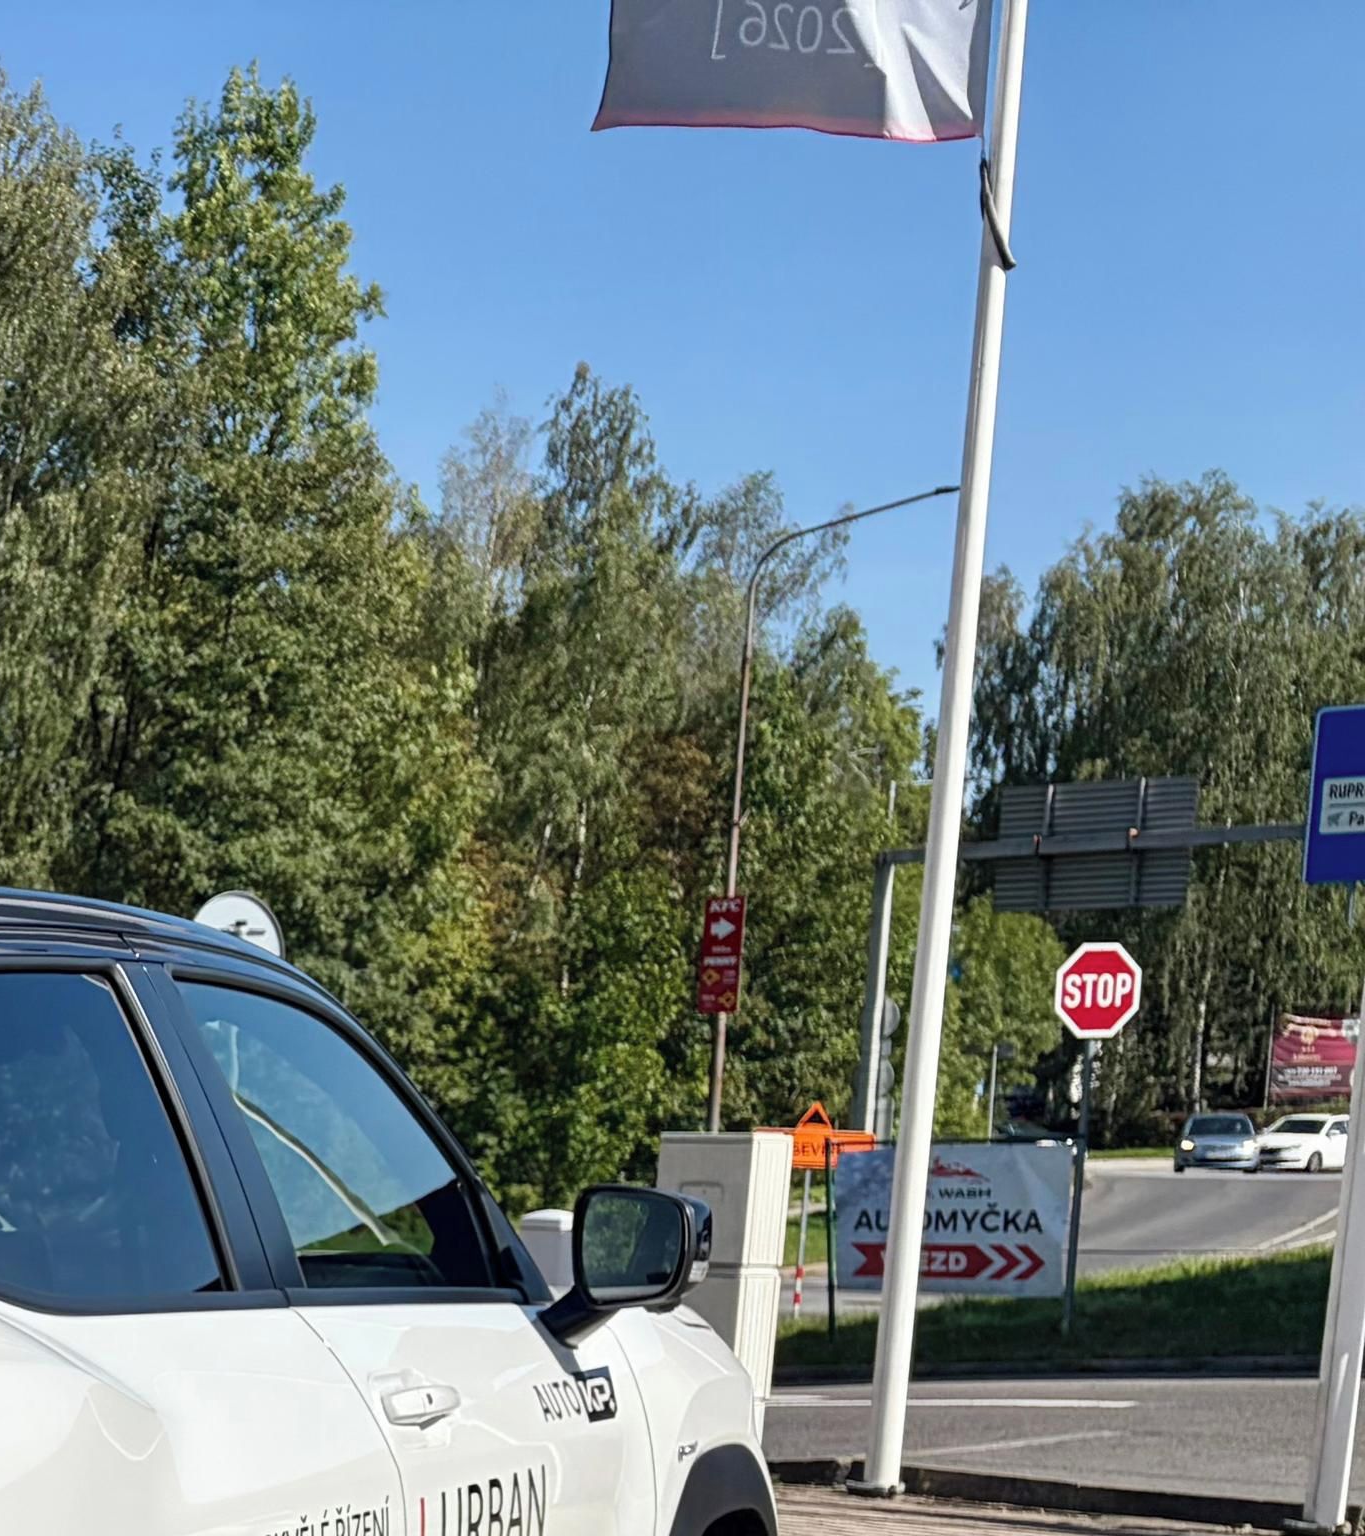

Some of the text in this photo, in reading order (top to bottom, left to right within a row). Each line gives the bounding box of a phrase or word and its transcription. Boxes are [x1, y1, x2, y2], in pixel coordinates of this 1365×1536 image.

[710, 899, 741, 913] KFC
[1064, 973, 1132, 1009] STOP
[854, 1202, 1043, 1234] AUMYČKA
